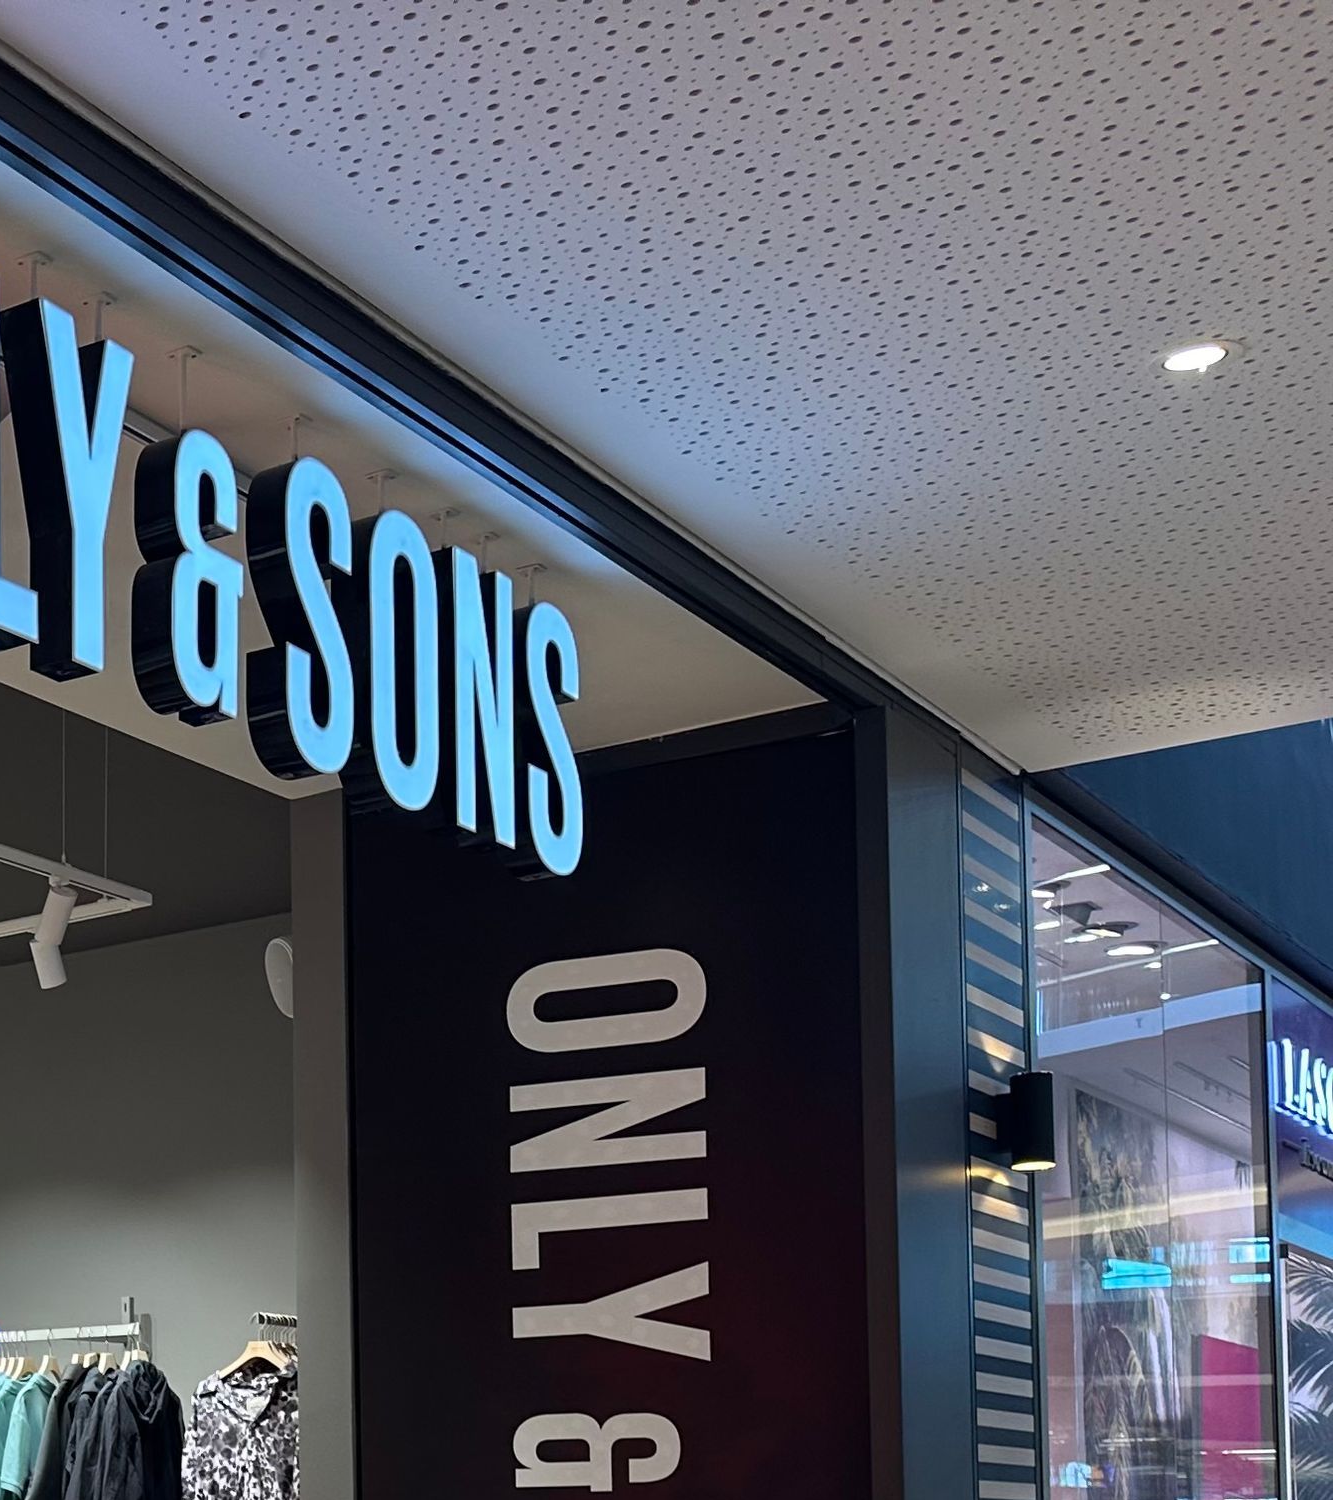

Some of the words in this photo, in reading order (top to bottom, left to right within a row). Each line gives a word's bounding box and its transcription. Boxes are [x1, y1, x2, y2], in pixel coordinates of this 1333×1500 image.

[173, 429, 244, 720] &
[285, 456, 583, 876] SONS
[506, 948, 711, 1361] ONLY
[513, 1412, 681, 1493] &
